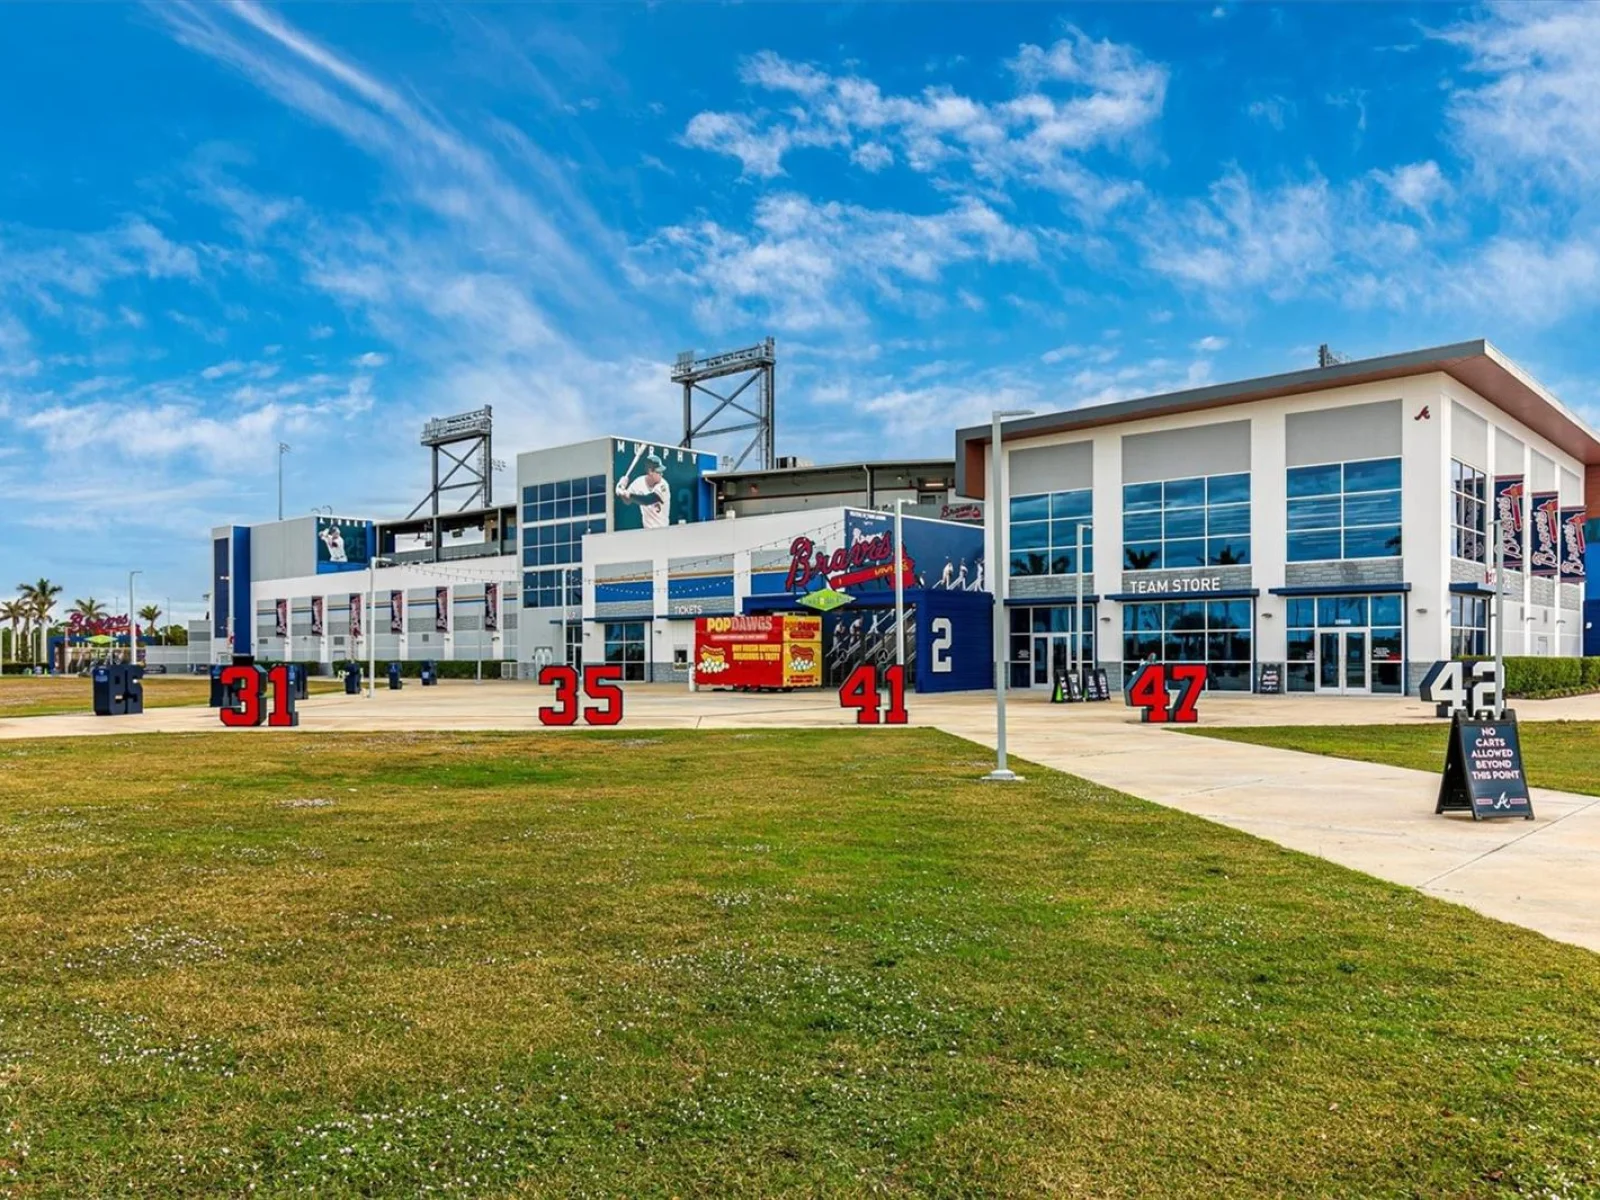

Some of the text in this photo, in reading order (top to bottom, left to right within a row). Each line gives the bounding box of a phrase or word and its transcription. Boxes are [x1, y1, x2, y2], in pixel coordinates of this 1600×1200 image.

[617, 440, 698, 465] MURPHY
[785, 530, 892, 592] Braves
[1130, 577, 1221, 594] TEAM STORE
[674, 604, 703, 615] TICKETS
[706, 615, 773, 633] POPDAWGS
[932, 617, 952, 673] 2
[220, 664, 293, 727] 31
[538, 664, 624, 726] 35
[839, 664, 909, 724] 41
[1129, 663, 1209, 723] 47
[1430, 661, 1506, 719] 42
[1481, 727, 1496, 736] NO
[1475, 738, 1506, 747] CARTS
[1471, 749, 1514, 758] ALLOWED
[1471, 770, 1520, 780] THIS POINT
[1475, 760, 1512, 769] BEYOND
